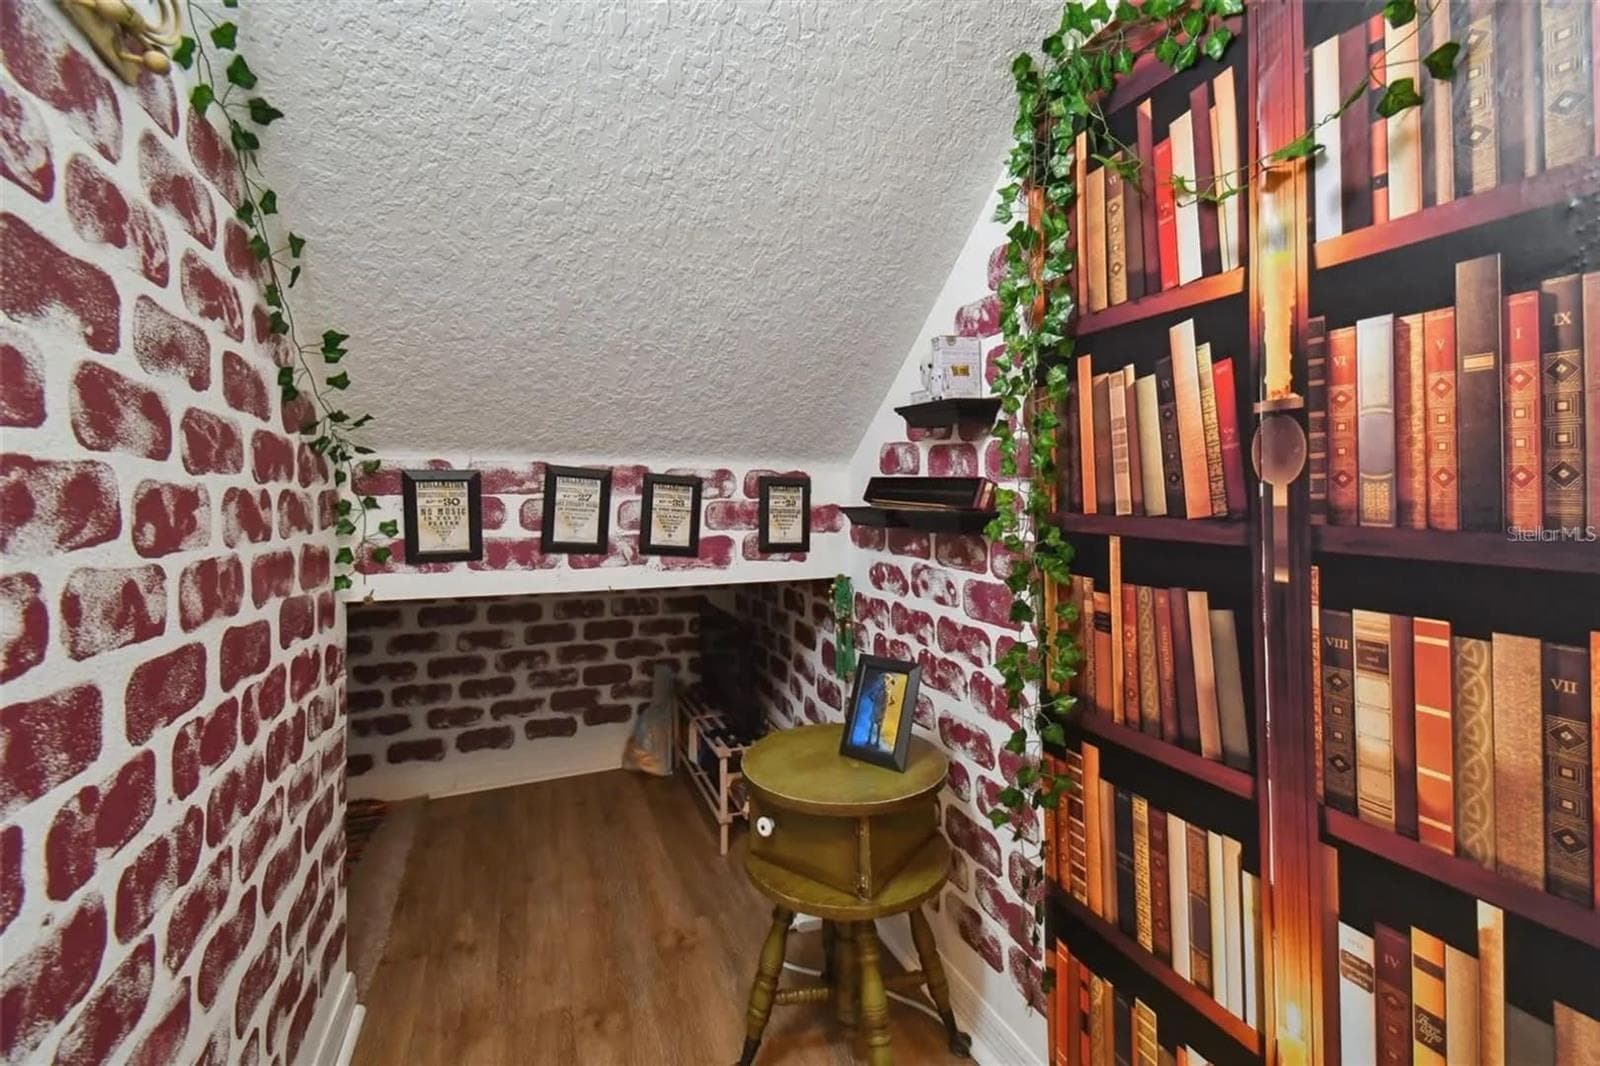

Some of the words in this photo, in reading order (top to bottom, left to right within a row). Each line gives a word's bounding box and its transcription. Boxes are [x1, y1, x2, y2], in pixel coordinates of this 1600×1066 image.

[1554, 311, 1571, 326] IX
[443, 497, 460, 506] 30
[437, 507, 466, 515] MUSIC
[1325, 636, 1349, 650] VIII
[1550, 677, 1578, 696] VII
